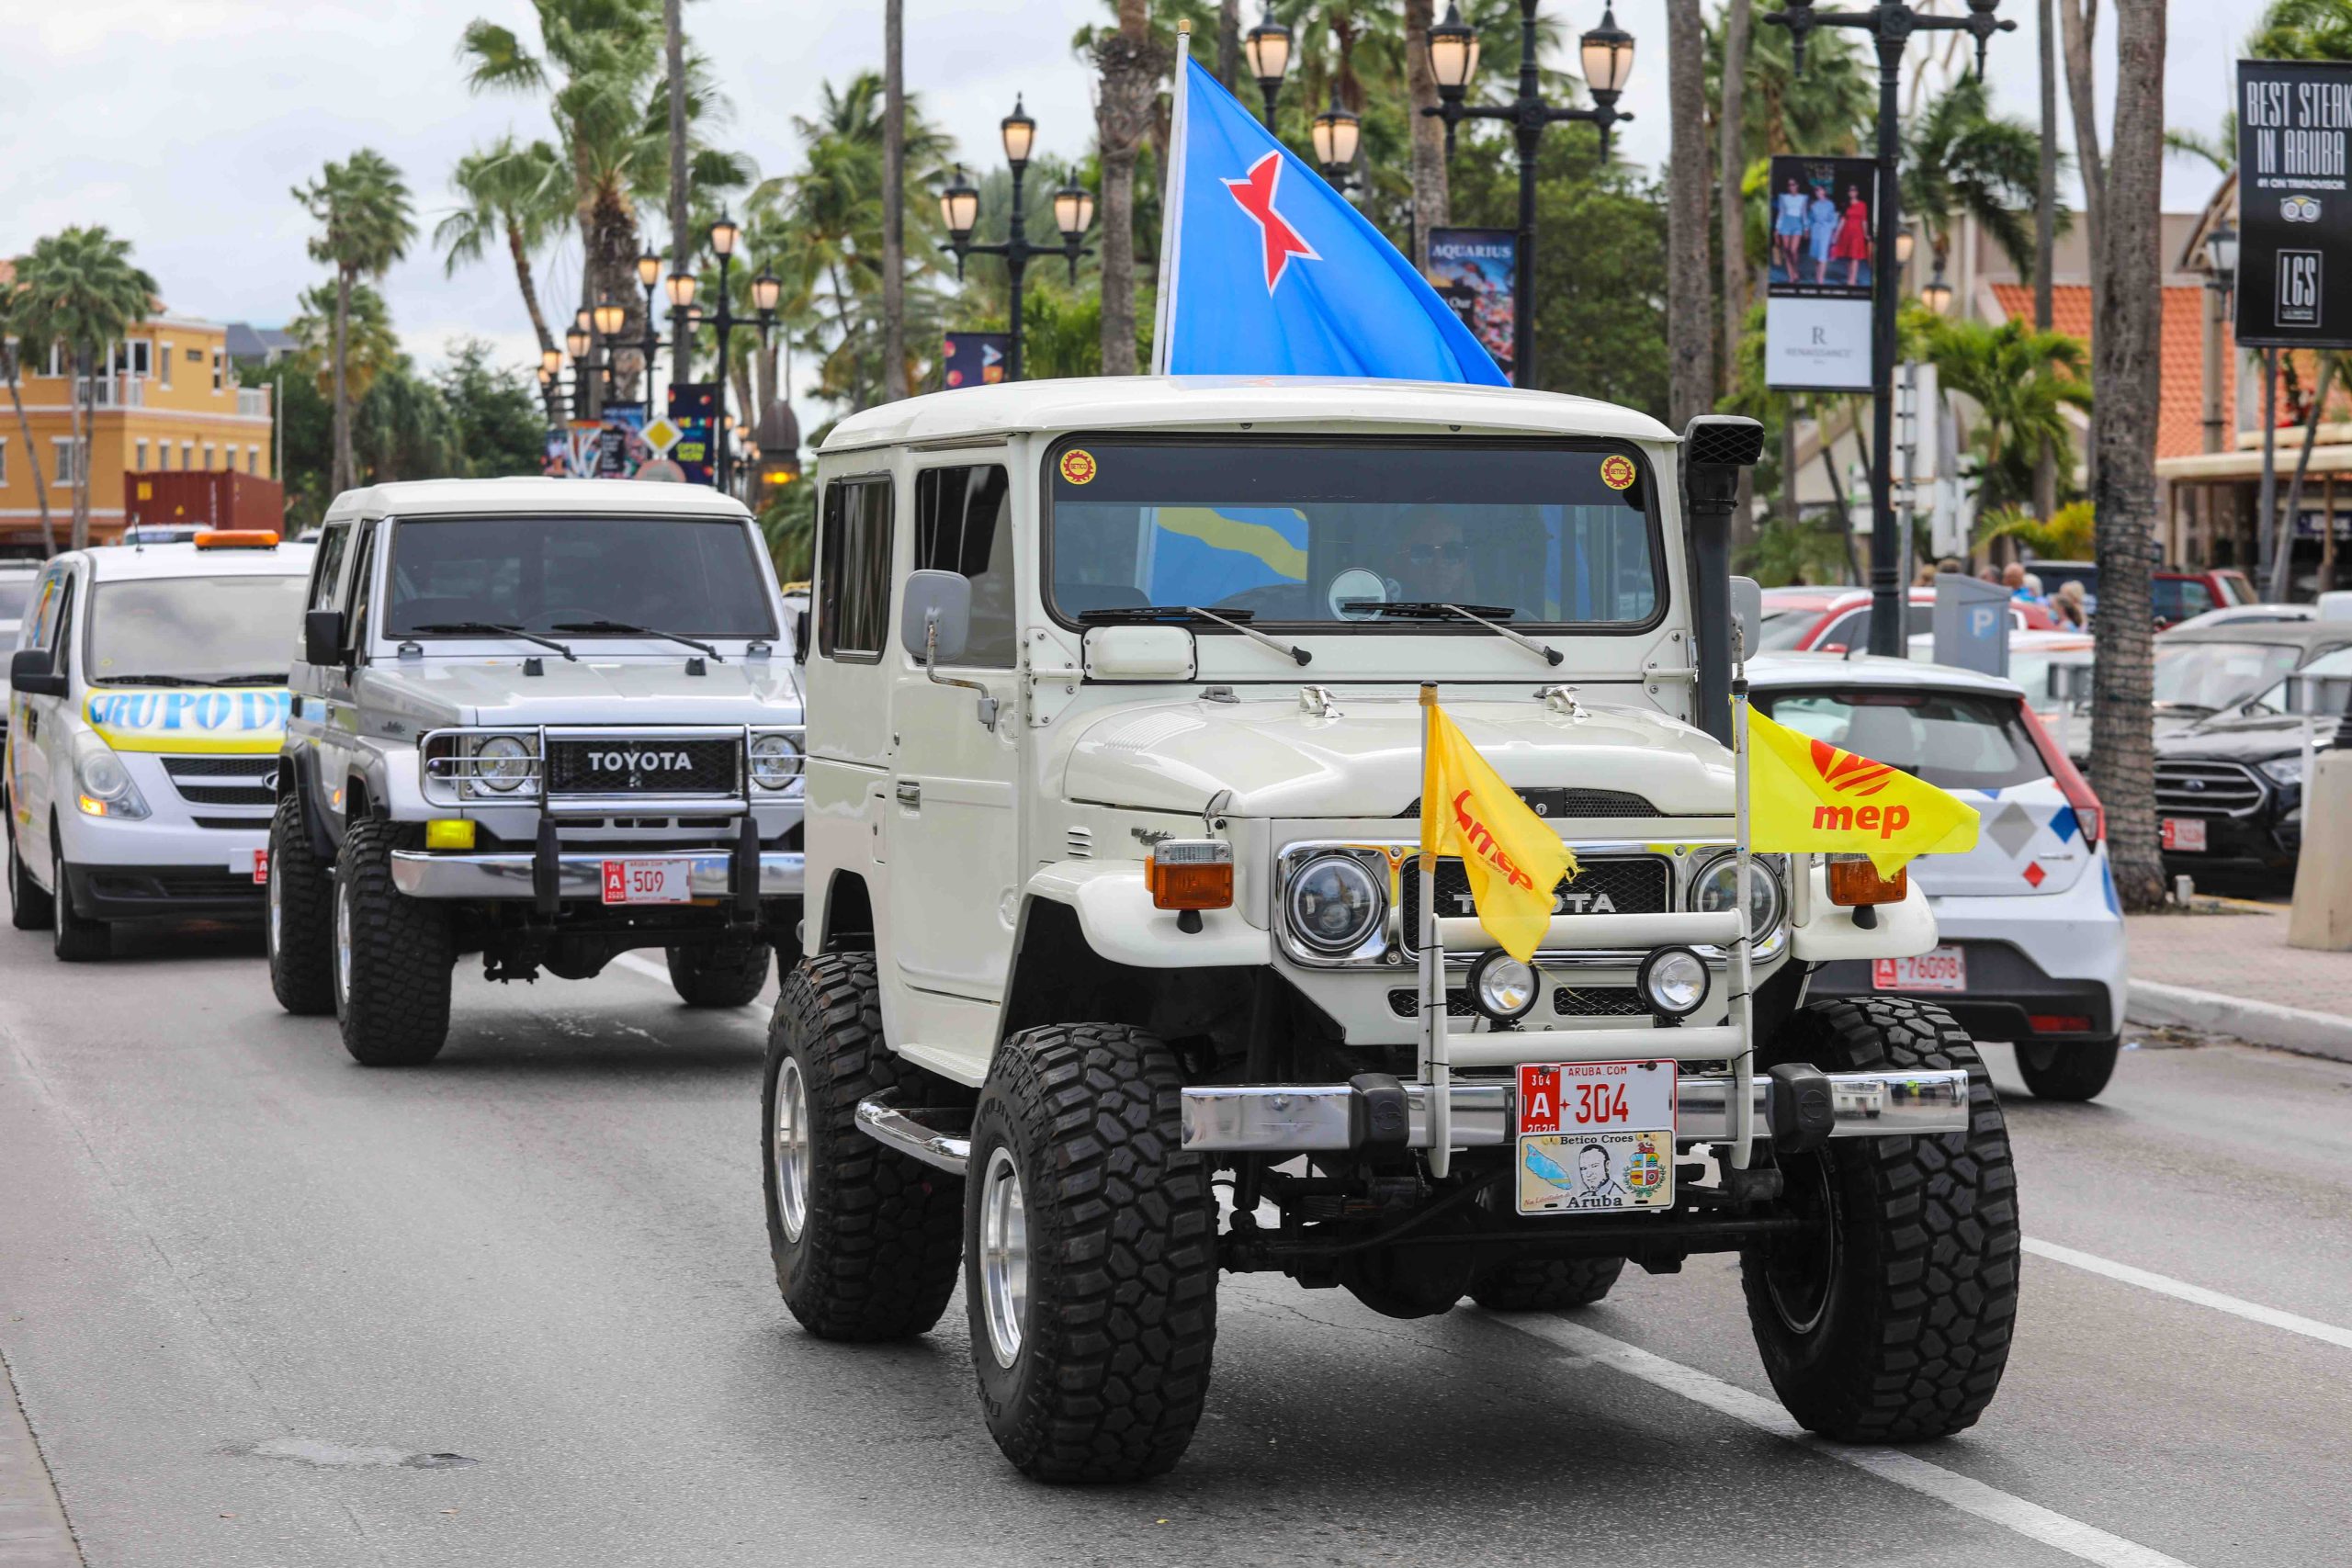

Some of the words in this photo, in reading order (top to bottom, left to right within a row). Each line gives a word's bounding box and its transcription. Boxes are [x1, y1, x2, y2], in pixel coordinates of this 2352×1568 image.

[2246, 81, 2292, 127] BEST
[2256, 130, 2277, 174] IN
[2284, 130, 2346, 175] ARUBA
[1432, 243, 1511, 258] AQUARIUS
[1812, 326, 1827, 344] R
[1973, 608, 1995, 637] P
[588, 751, 693, 770] TOYOTA
[1813, 804, 1910, 839] mep
[609, 874, 621, 889] A
[1532, 1074, 1551, 1087] 304
[1531, 1092, 1551, 1118] A
[1559, 1135, 1598, 1145] Betico
[1601, 1134, 1634, 1144] Croes
[1566, 1194, 1623, 1210] Aruba
